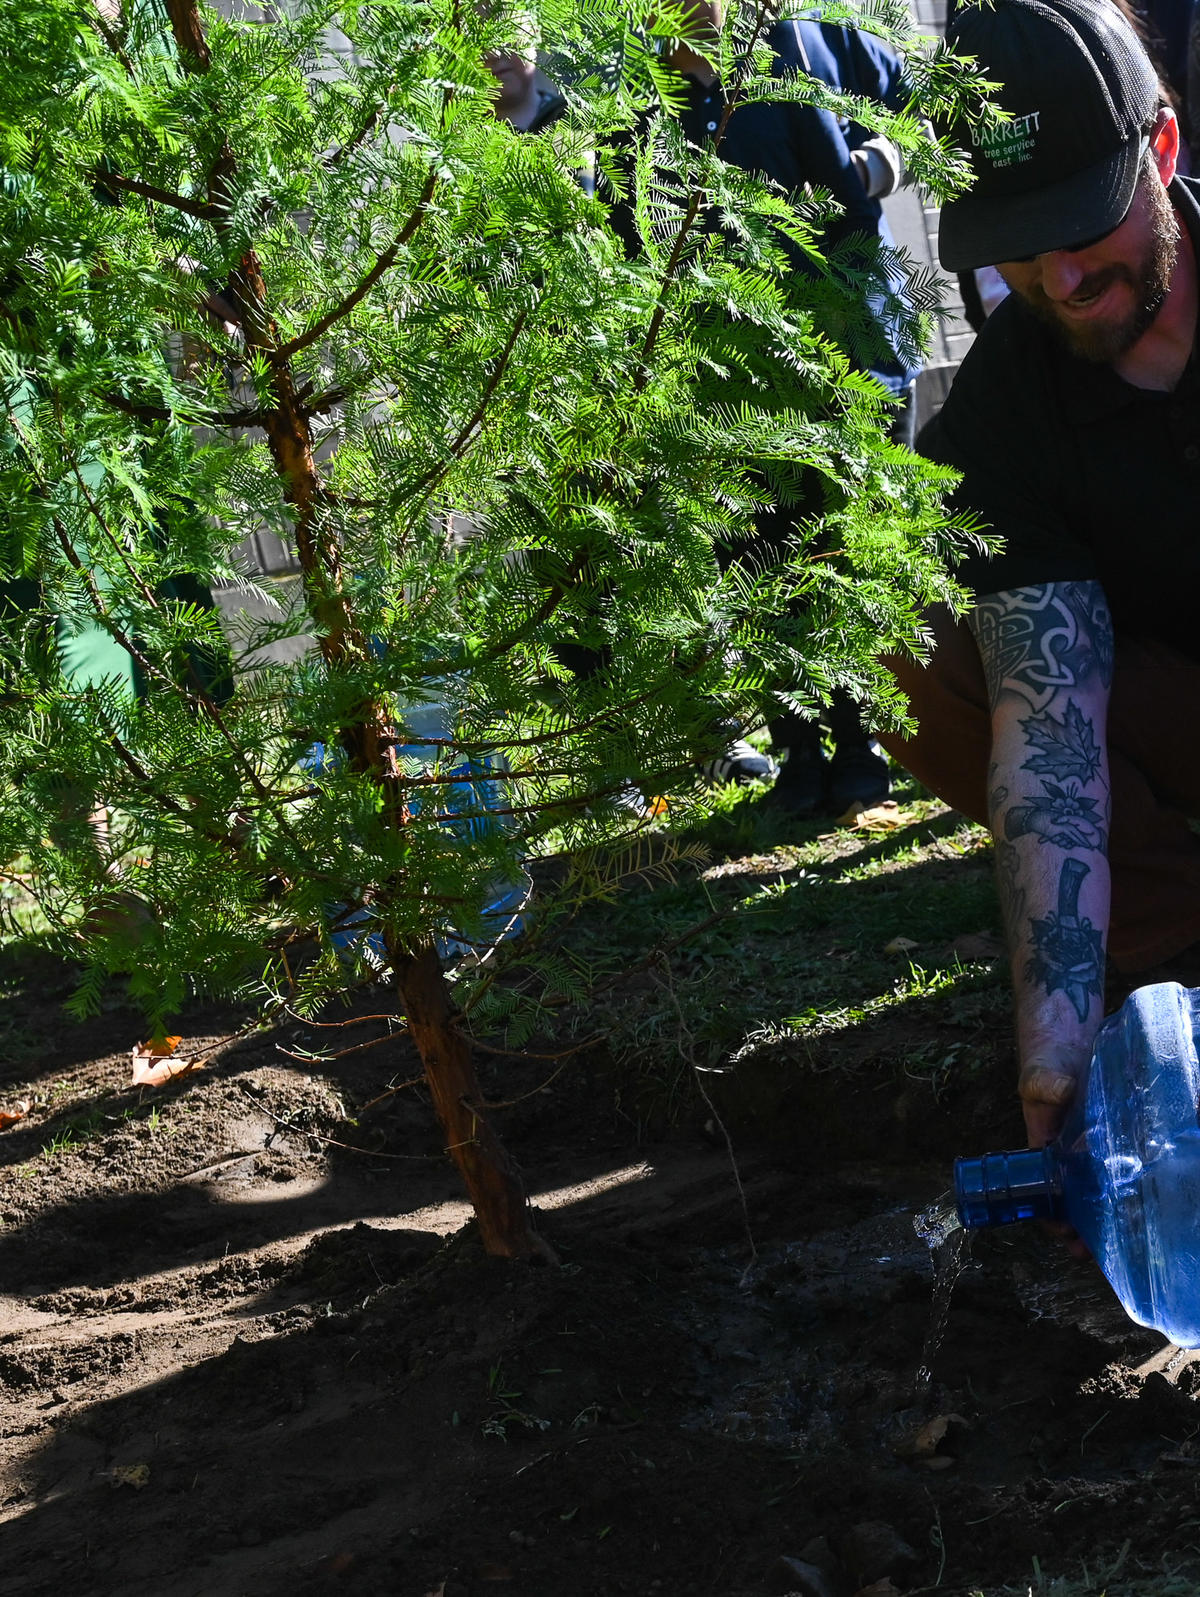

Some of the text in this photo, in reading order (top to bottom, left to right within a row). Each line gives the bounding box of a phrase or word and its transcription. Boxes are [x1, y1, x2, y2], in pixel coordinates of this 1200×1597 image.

[971, 111, 1040, 147] BARRETT
[984, 139, 1036, 159] tree service
[992, 152, 1033, 169] east inc.
